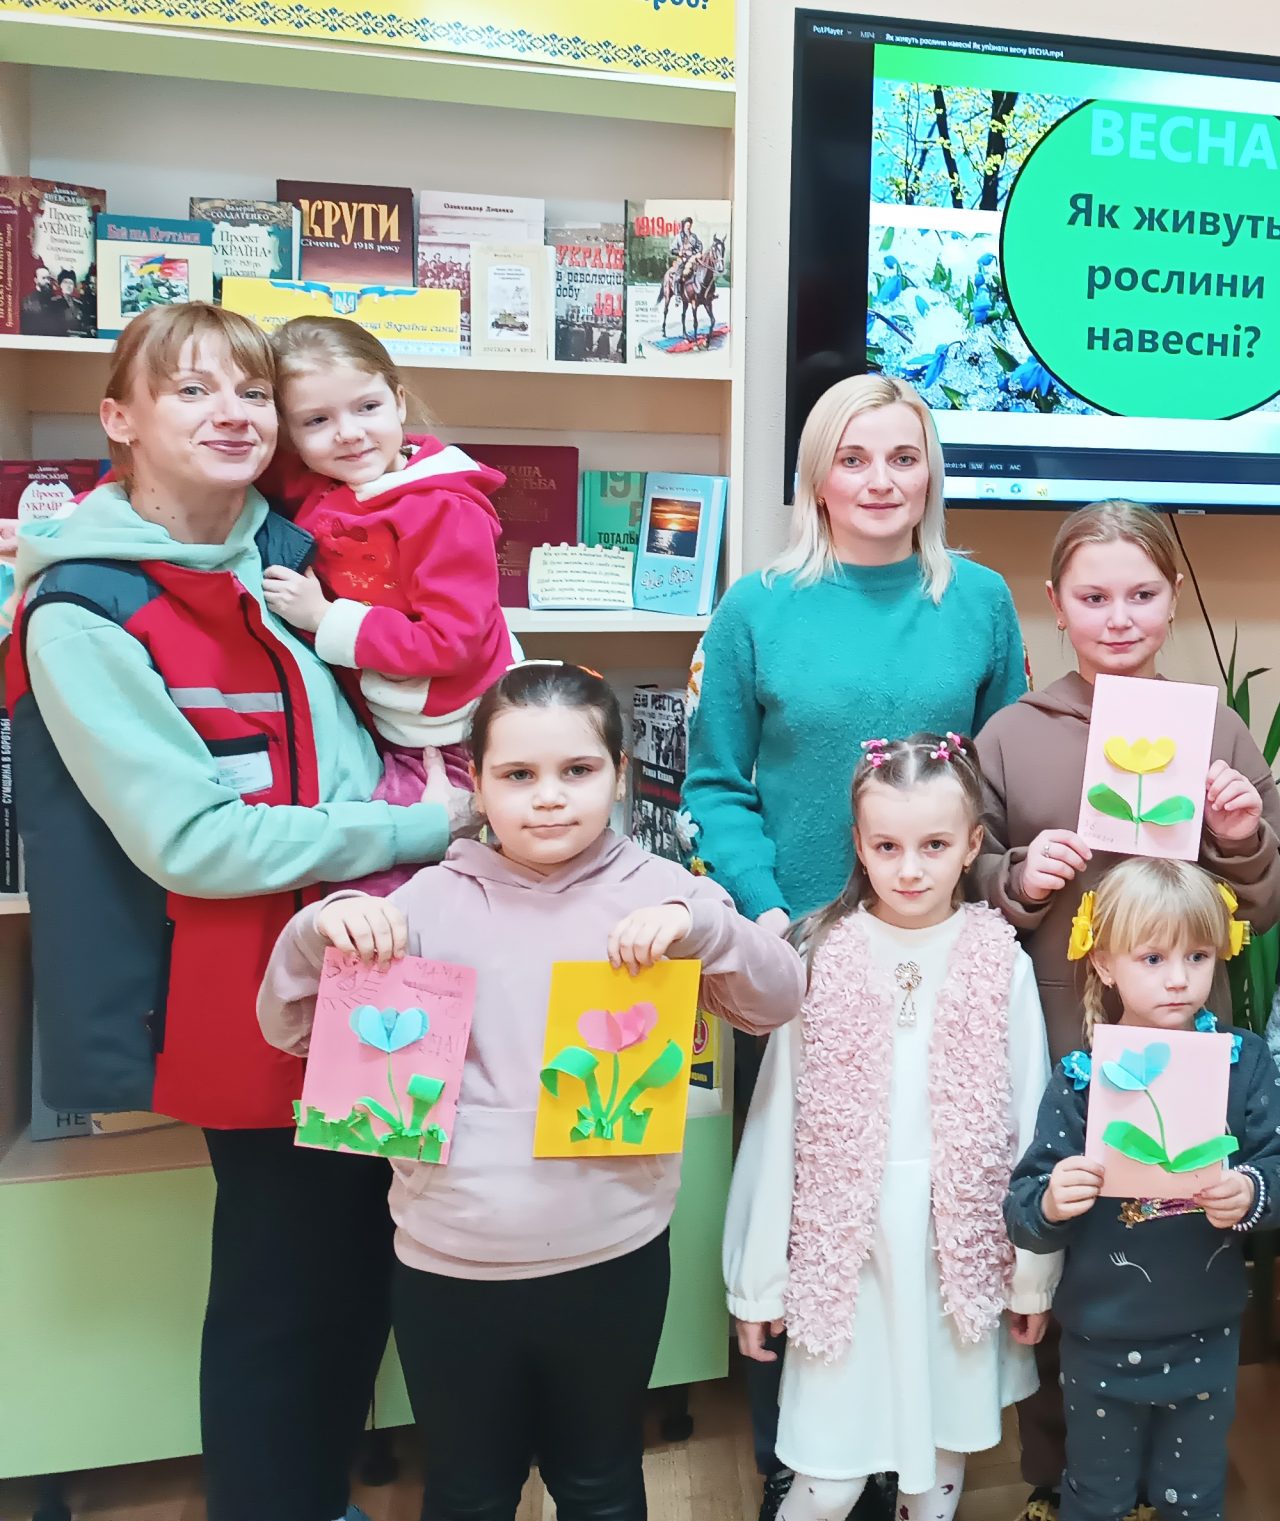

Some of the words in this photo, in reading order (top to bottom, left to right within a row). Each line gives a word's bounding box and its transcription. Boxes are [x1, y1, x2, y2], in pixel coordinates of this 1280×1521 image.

[1090, 108, 1278, 170] ВЕСНА
[299, 199, 401, 245] КРУТИ
[1066, 193, 1121, 229] Як
[220, 230, 259, 244] Проект
[300, 238, 341, 249] Січень
[353, 242, 375, 251] 1918
[377, 245, 401, 254] року
[555, 243, 625, 271] УКРАЇН
[556, 286, 580, 301] добу
[567, 272, 625, 286] революцій
[1087, 265, 1265, 299] рослини
[1087, 324, 1261, 358] навесні?
[2, 764, 12, 805] СУМЩИНА
